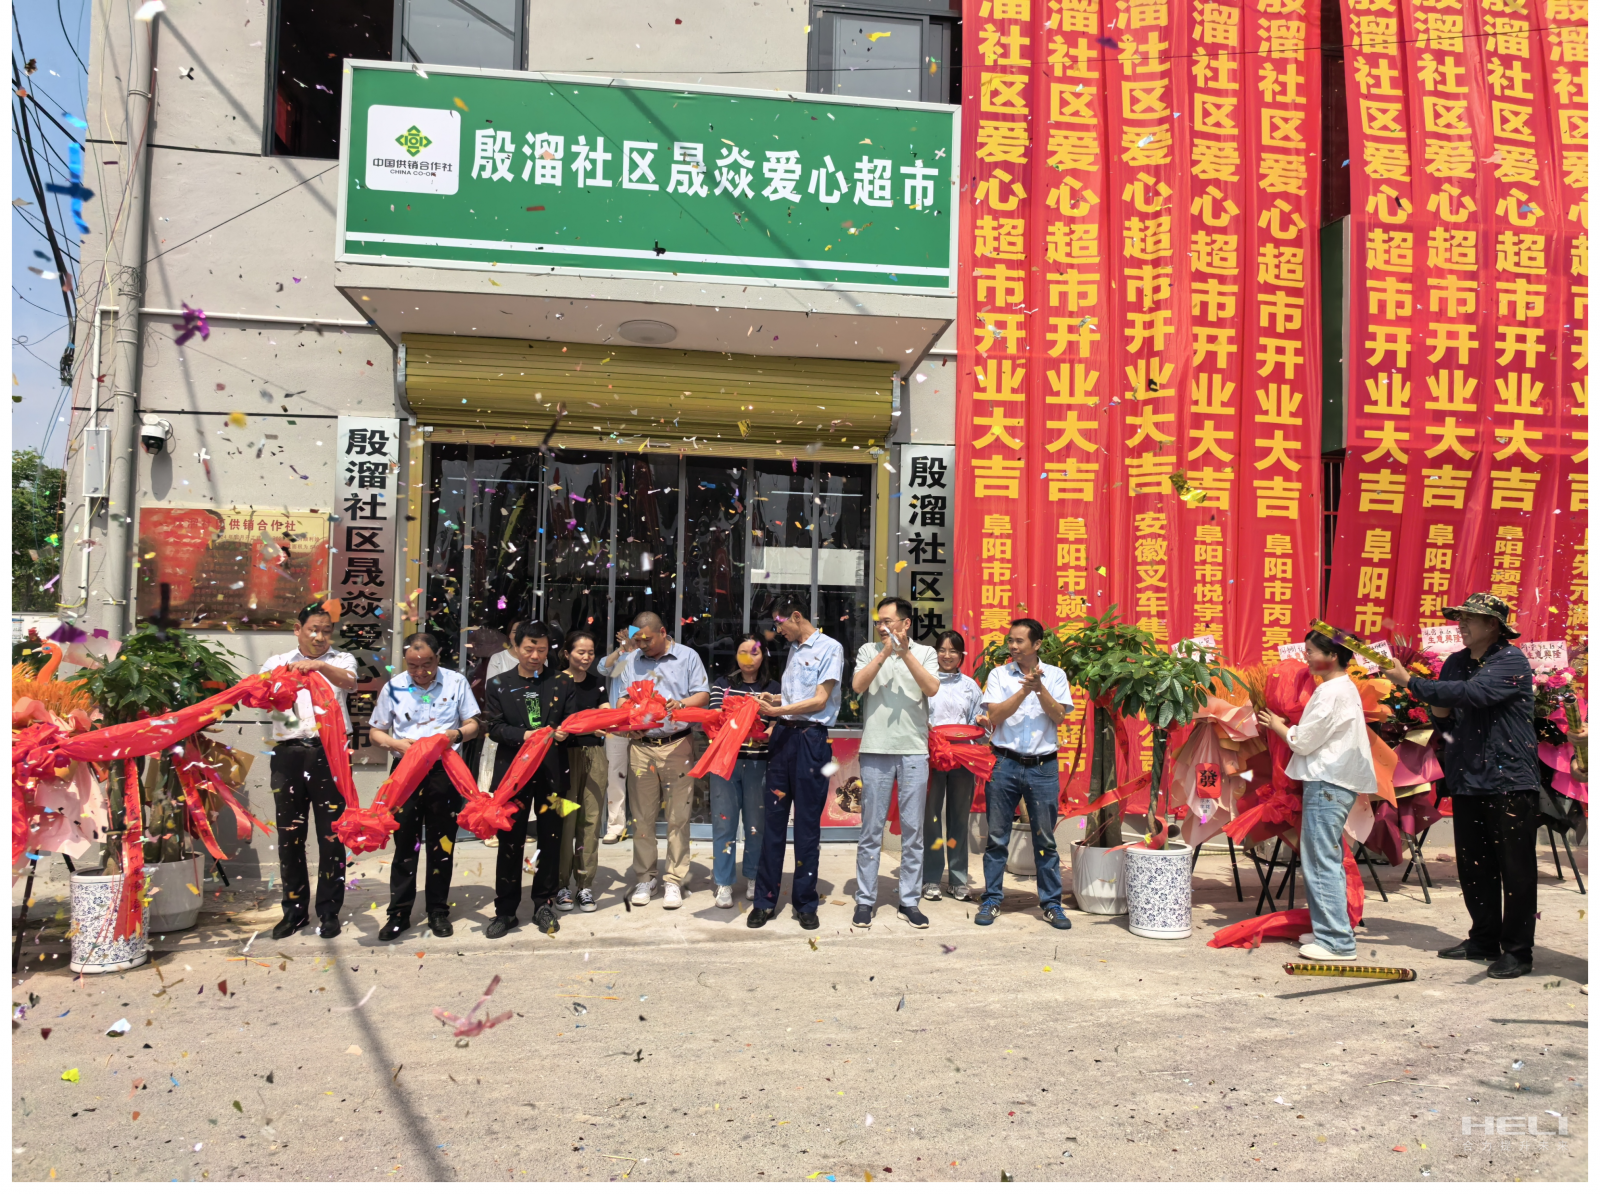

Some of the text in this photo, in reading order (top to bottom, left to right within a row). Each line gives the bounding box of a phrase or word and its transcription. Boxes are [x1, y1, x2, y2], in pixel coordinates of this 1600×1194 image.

[372, 158, 453, 172] 中国供销合作社
[471, 128, 939, 211] 殷溜社区晟焱爱心超市
[1412, 0, 1479, 509] 溜社区爱心超市开业大吉
[908, 455, 948, 642] 殷溜社区快
[1134, 512, 1169, 654] 安徽叉车集
[1200, 769, 1218, 788] 發
